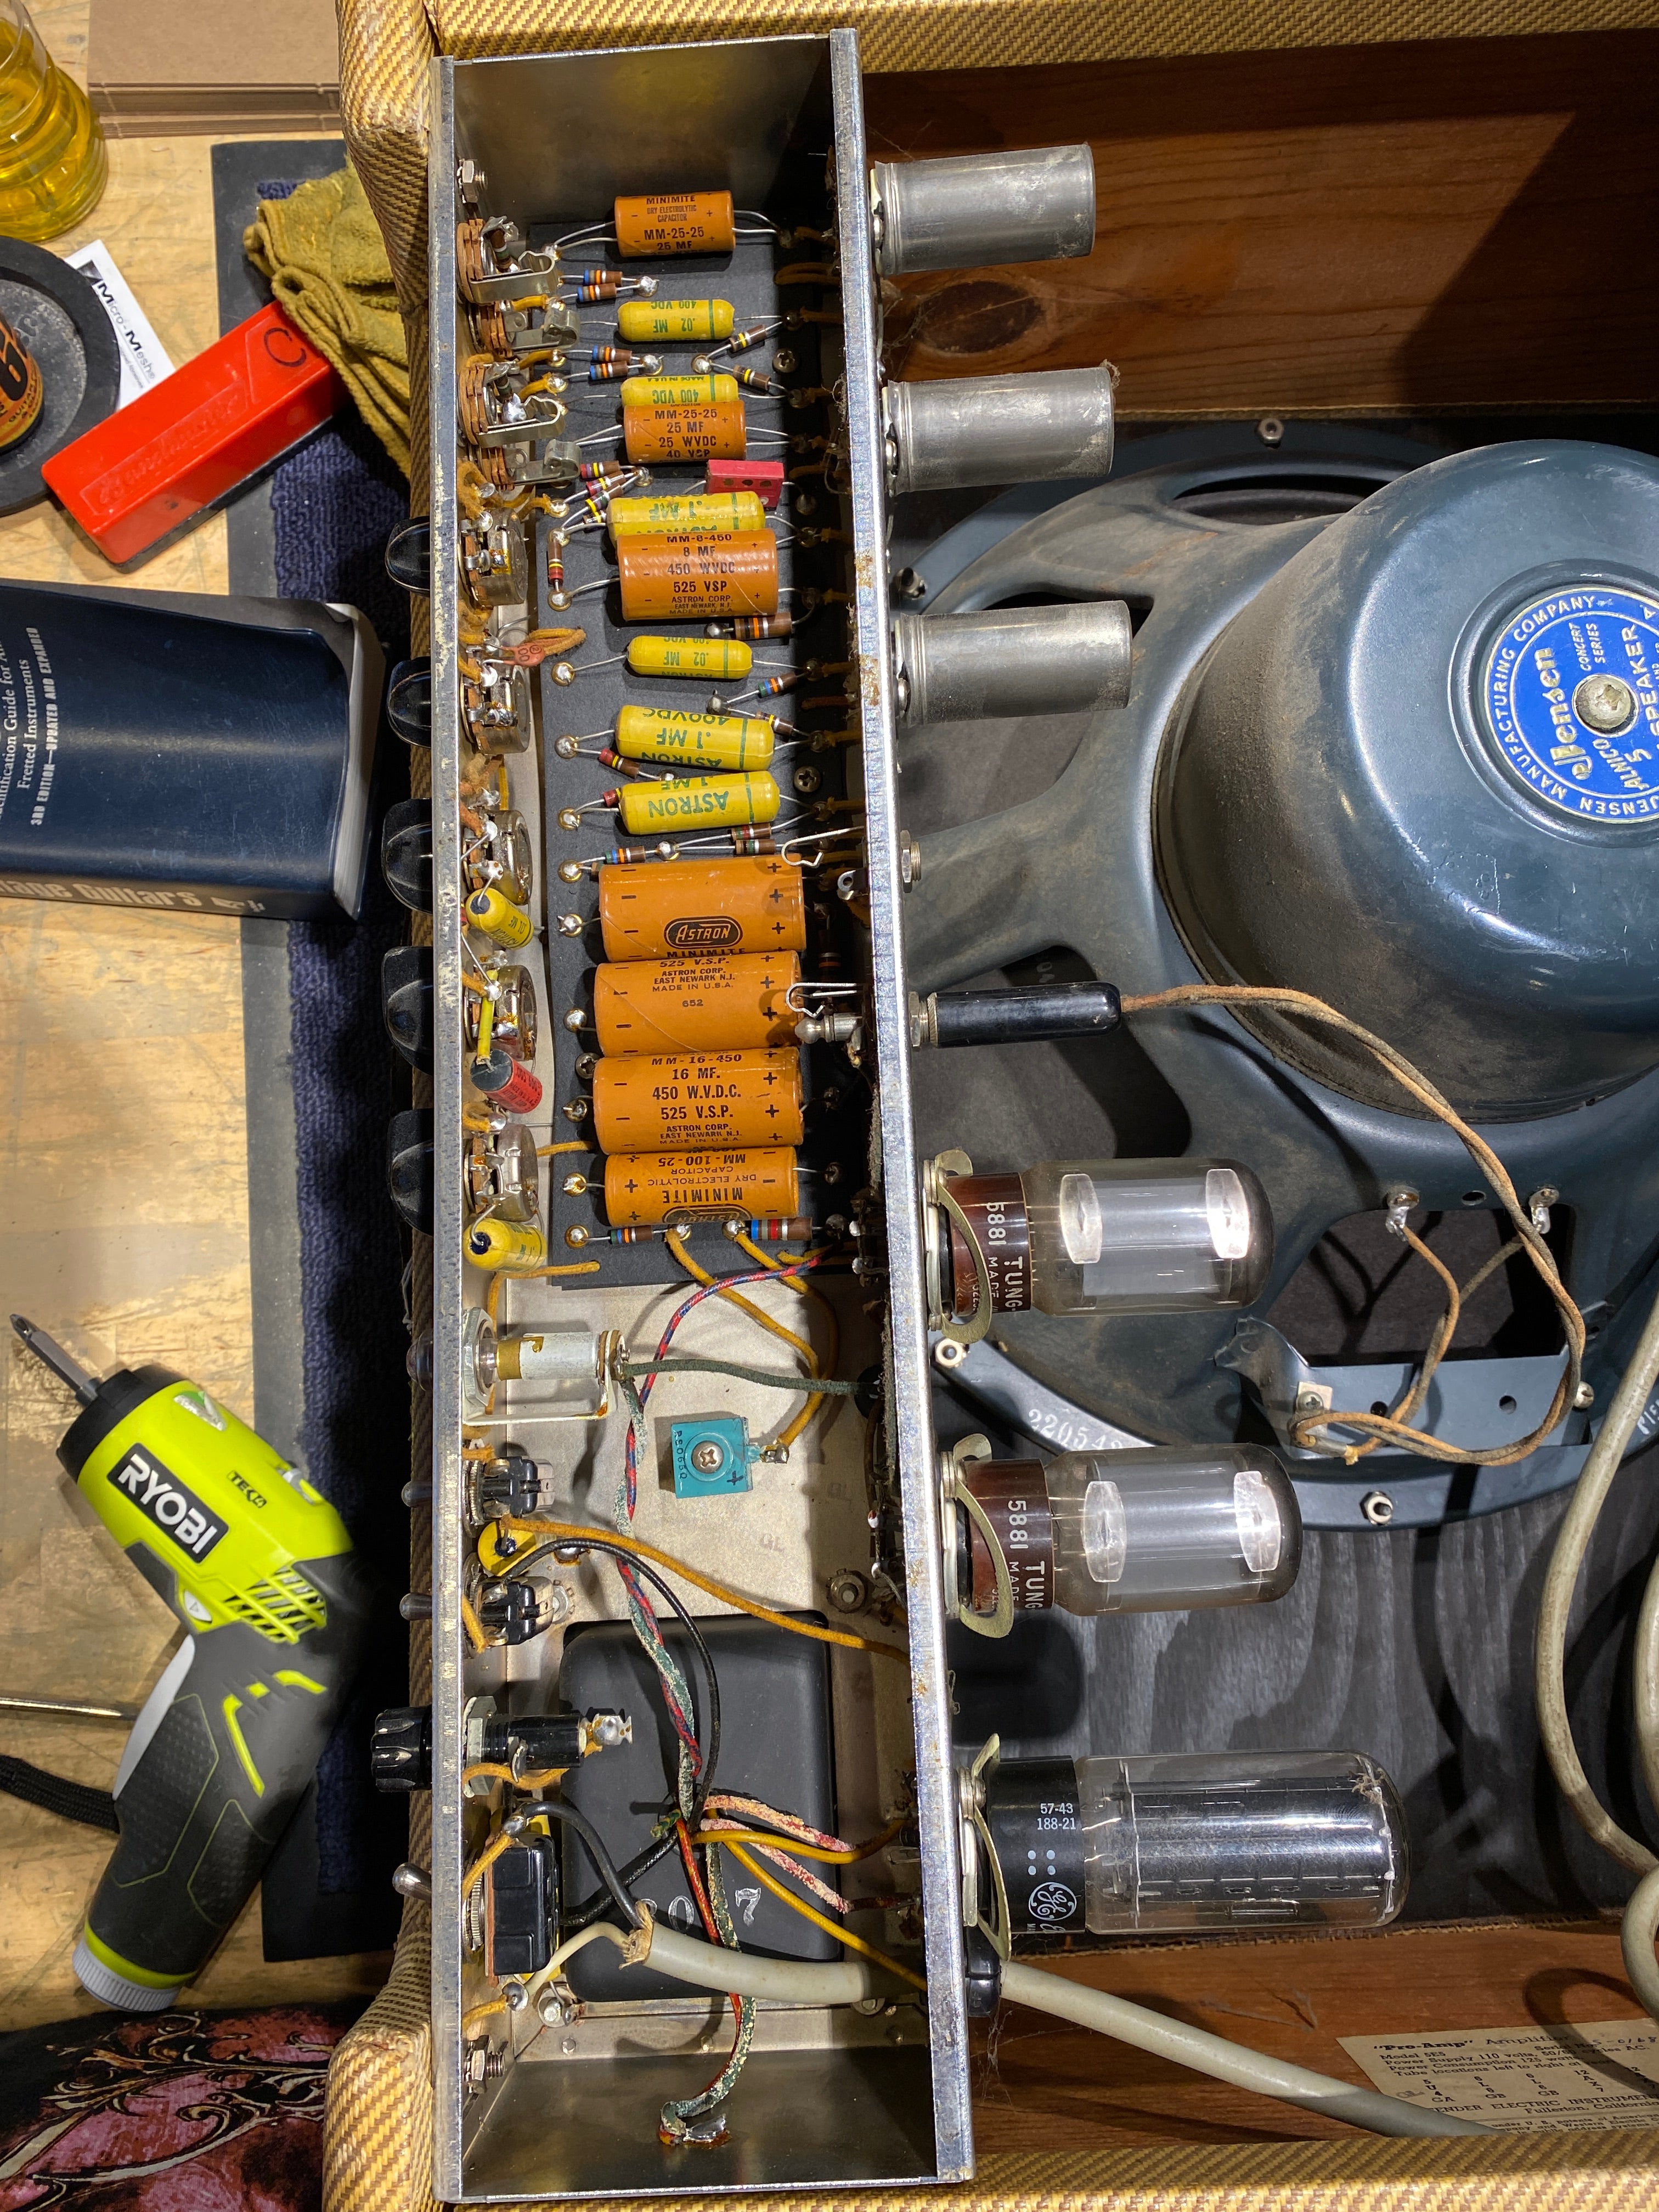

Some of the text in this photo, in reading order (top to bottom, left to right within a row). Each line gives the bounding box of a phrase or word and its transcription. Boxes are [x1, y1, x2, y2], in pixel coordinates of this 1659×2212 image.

[646, 195, 695, 205] MINIMITE
[660, 205, 697, 214] ELECTROLYTIC
[657, 213, 687, 223] CAPACITOR
[644, 227, 704, 240] MM-25-25
[657, 240, 692, 251] 25 MF
[651, 300, 696, 310] 400 VDC
[653, 318, 695, 333] .02 MF
[652, 389, 699, 404] 400 VDC
[655, 409, 718, 419] MM-25-25
[667, 421, 704, 433] 25 MF
[659, 436, 717, 448] 25 WVDC
[666, 449, 710, 458] 40 VSP
[648, 502, 680, 521] MF
[667, 533, 732, 543] MM-8-450
[684, 546, 716, 557] 8 MF
[667, 561, 735, 575] 450 WVDC
[673, 580, 727, 593] 525 VSP
[1513, 595, 1596, 642] COMPANY
[1568, 623, 1592, 671] CONCERT
[1585, 623, 1606, 663] SERIES
[663, 651, 709, 666] .02 MF
[1622, 624, 1659, 737] SPEAKER
[2, 689, 18, 731] Guide
[1534, 647, 1593, 780] Jensen
[17, 659, 37, 790] Fretted Instruments
[26, 627, 57, 826] 3RD AND EXPANDED
[1493, 647, 1567, 800] MANUFACTURING
[656, 728, 710, 749] .1 MF
[642, 752, 722, 767] ASTRON
[1624, 749, 1652, 763] 5
[1593, 739, 1649, 790] ALNICO
[648, 791, 729, 818] ASTRON
[73, 882, 202, 907] Guitars
[672, 922, 734, 946] ASTRON
[667, 948, 746, 958] MINIMITE
[680, 974, 715, 983] NEWARK
[682, 999, 704, 1007] 652
[672, 1067, 720, 1080] 16 MF.
[652, 1084, 741, 1100] 450 W.V.D.C.
[661, 1105, 733, 1120] 525 V.S.P.
[671, 1166, 733, 1175] CAPACITOR
[648, 1174, 756, 1187] DRY ELECTROLYTIC
[662, 1187, 743, 1204] MINIMITE
[987, 1203, 1007, 1245] 5881
[112, 1454, 217, 1554] RYOBI
[1008, 1500, 1029, 1549] 5881
[1040, 1803, 1073, 1814] 57-43
[1037, 1818, 1076, 1830] 188-21
[1433, 2059, 1516, 2068] Consumption
[1490, 2101, 1560, 2109] ELECTRIC
